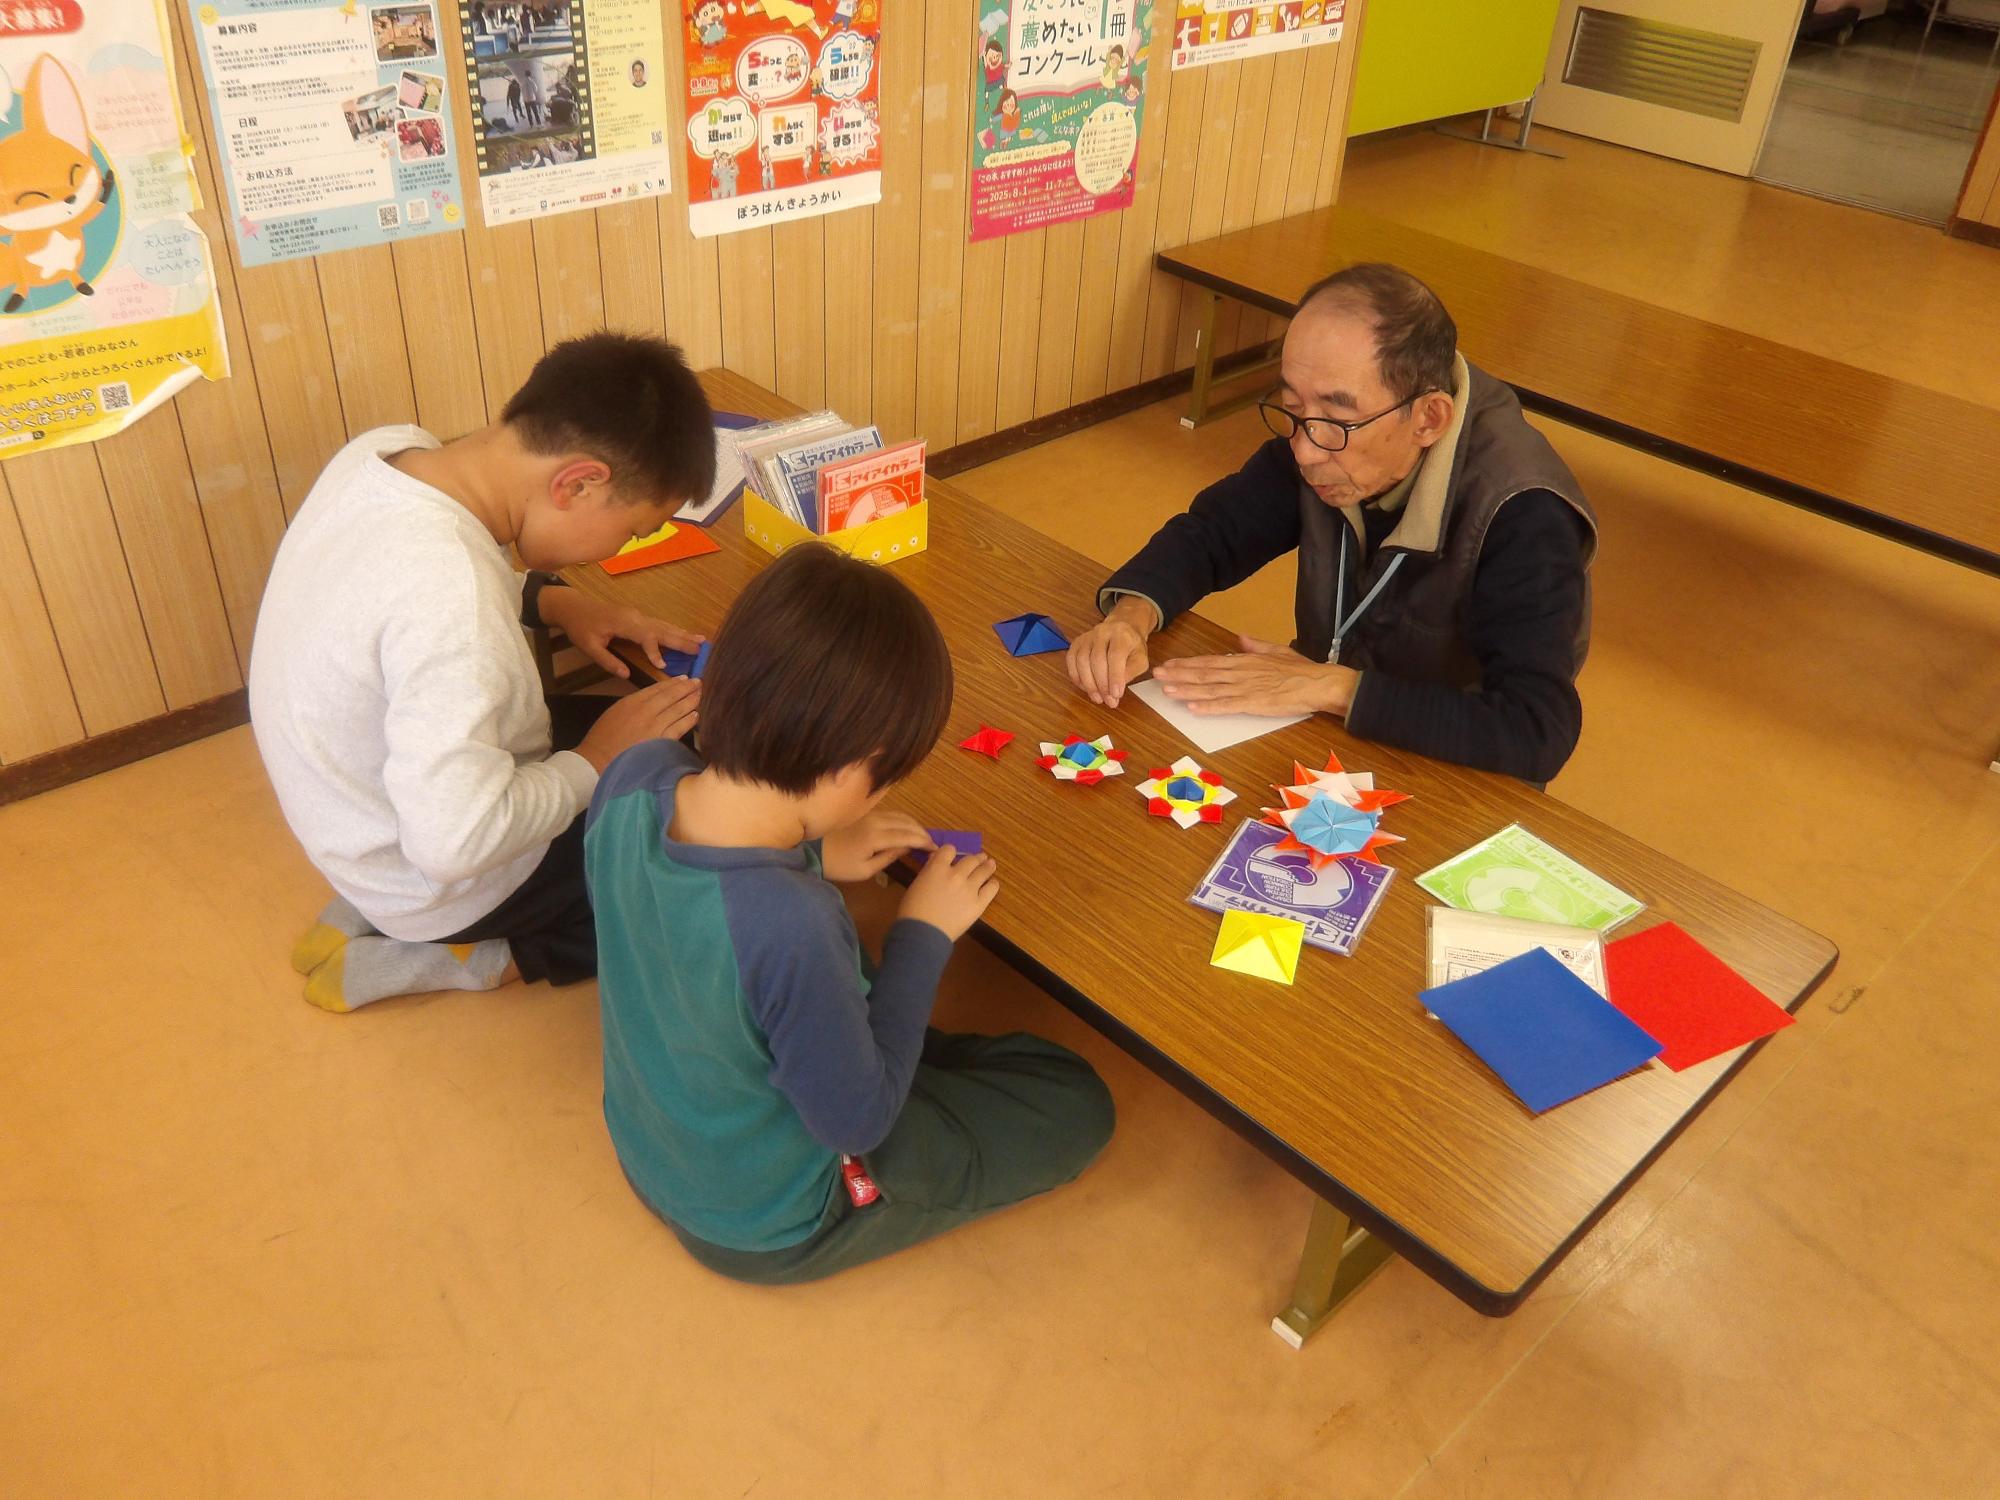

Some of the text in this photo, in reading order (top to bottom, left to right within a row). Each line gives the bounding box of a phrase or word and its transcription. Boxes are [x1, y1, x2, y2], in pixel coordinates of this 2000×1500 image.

[1020, 18, 1092, 50] 薦めたい
[747, 51, 783, 69] ちょっと
[1018, 45, 1096, 76] コンクール
[238, 116, 258, 128] 日程
[773, 115, 804, 130] れんらく
[833, 115, 862, 131] いのちを
[773, 131, 803, 146] する!!
[246, 166, 294, 182] お申込方法
[737, 190, 842, 220] ぼうはんきょうかい
[807, 442, 874, 466] アイアイカラー
[852, 459, 918, 485] アイアイカラー
